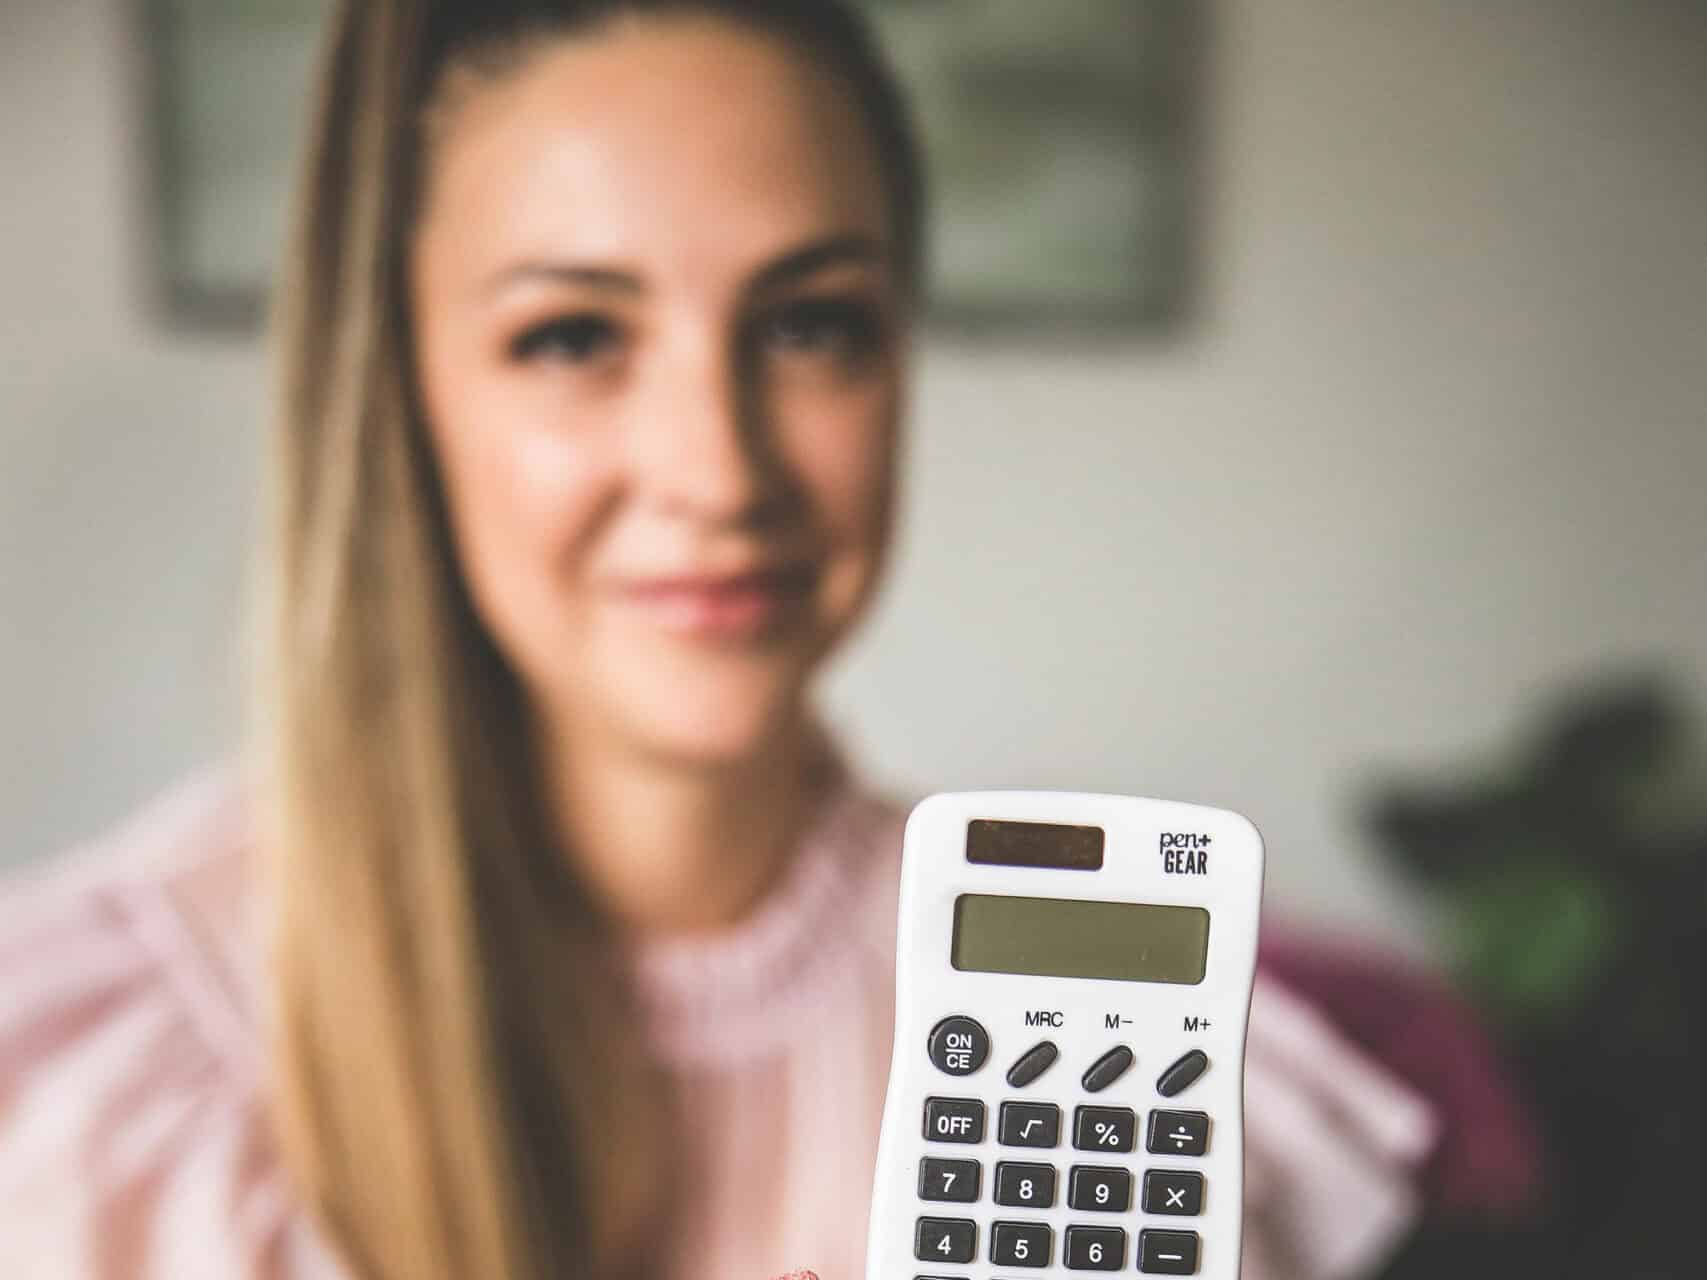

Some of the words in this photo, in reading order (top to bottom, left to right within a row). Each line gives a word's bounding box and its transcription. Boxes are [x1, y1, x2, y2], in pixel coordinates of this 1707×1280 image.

[1164, 850, 1207, 875] GEAR
[1026, 1011, 1063, 1027] MRC
[1184, 1017, 1210, 1031] M+
[947, 1034, 971, 1049] ON
[947, 1054, 970, 1068] CE
[938, 1116, 972, 1134] OFF
[1095, 1123, 1118, 1145] %
[943, 1173, 956, 1192] 7
[1020, 1180, 1032, 1199] 8
[1096, 1184, 1109, 1203] 9
[938, 1235, 951, 1254] 4
[1015, 1240, 1028, 1258] 5
[1089, 1243, 1102, 1262] 6
